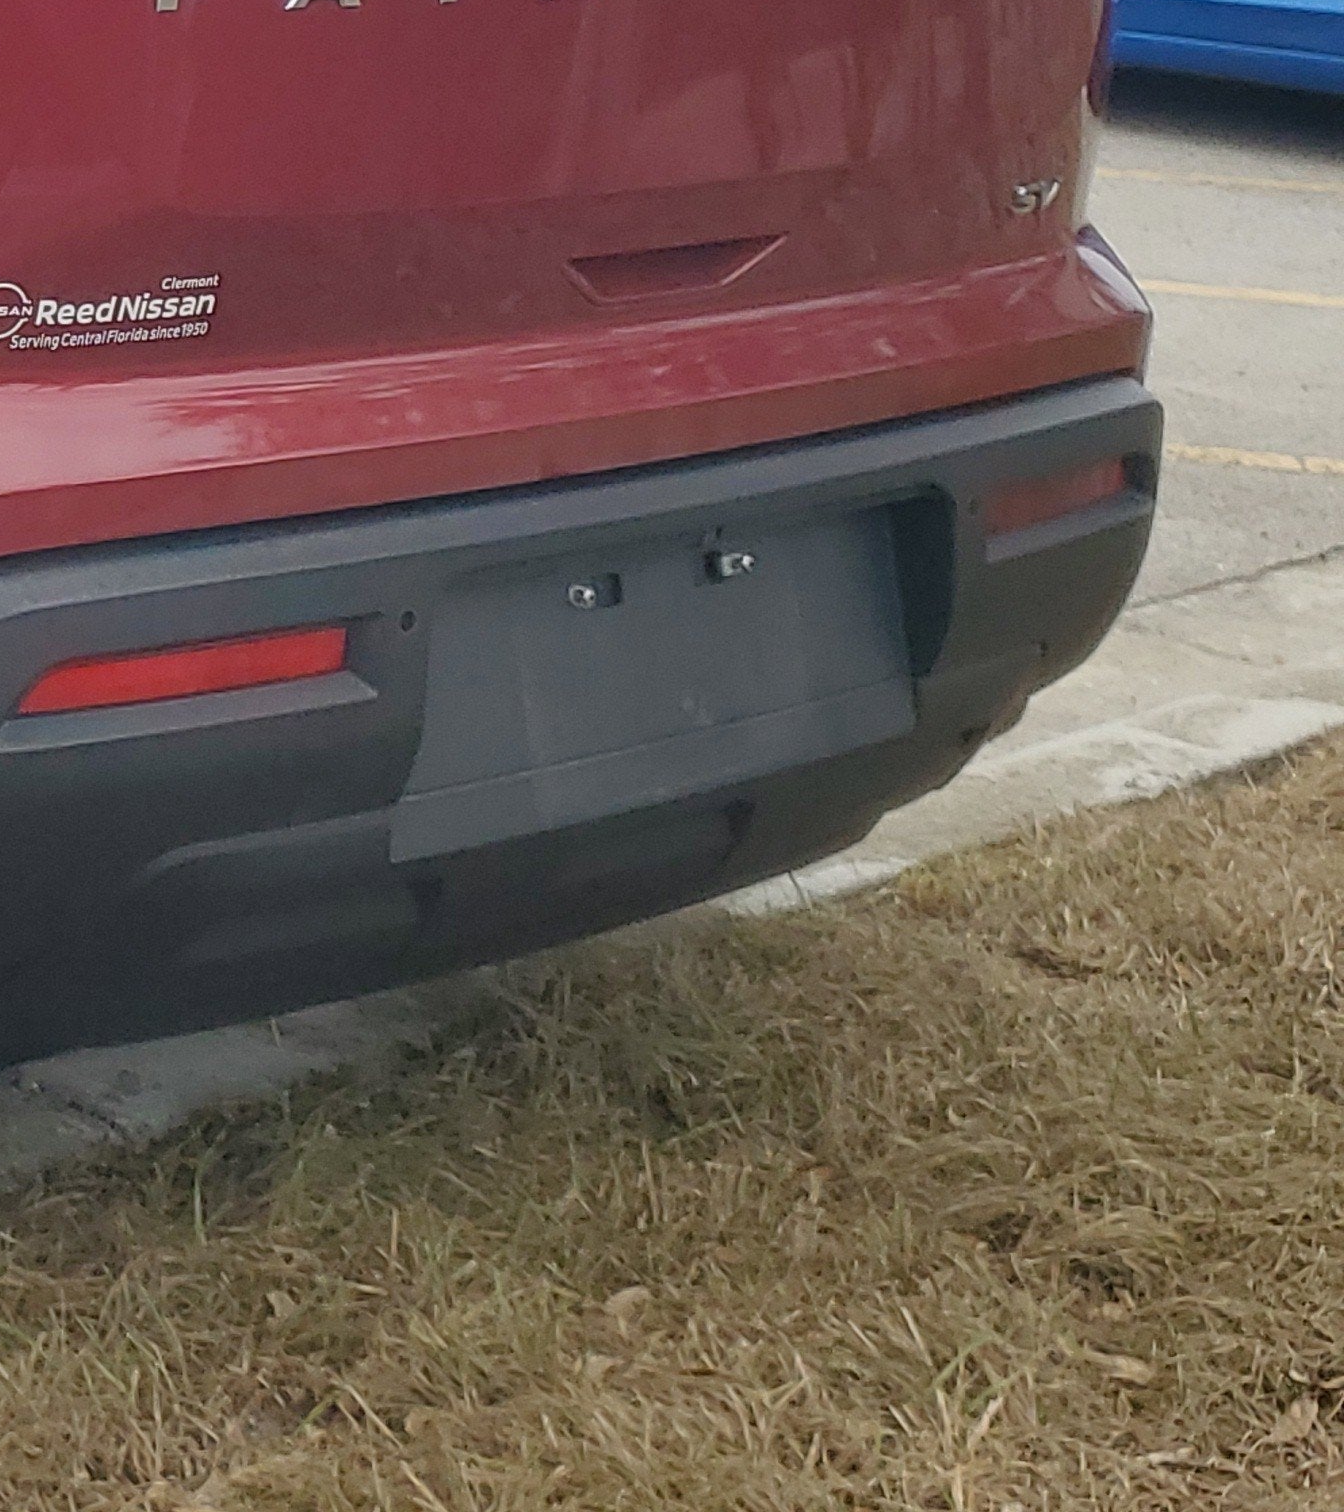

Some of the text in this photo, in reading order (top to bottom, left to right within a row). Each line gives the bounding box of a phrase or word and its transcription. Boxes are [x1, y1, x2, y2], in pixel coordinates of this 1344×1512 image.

[1011, 178, 1061, 214] SV
[161, 274, 220, 291] Clermont
[34, 292, 216, 326] Reed Nissan
[9, 321, 210, 351] Serving Central Florida since 1950
